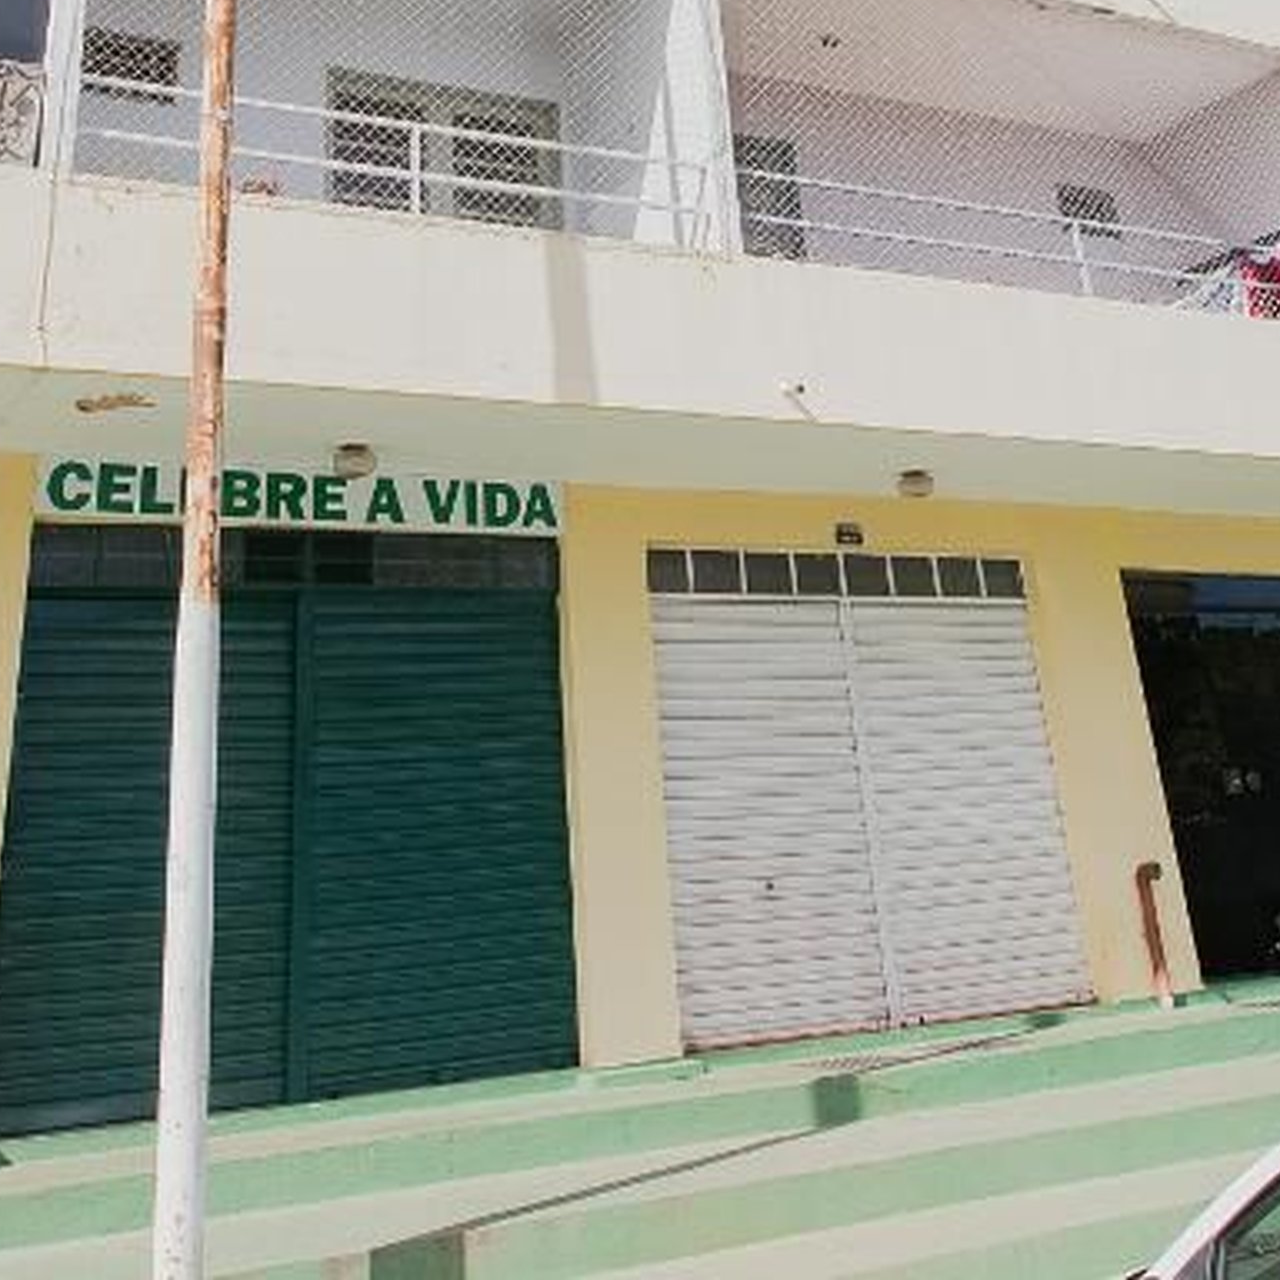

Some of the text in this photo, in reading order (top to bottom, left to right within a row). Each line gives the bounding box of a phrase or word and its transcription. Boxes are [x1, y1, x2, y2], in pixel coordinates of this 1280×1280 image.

[47, 460, 558, 528] CELBRE A VIDA
